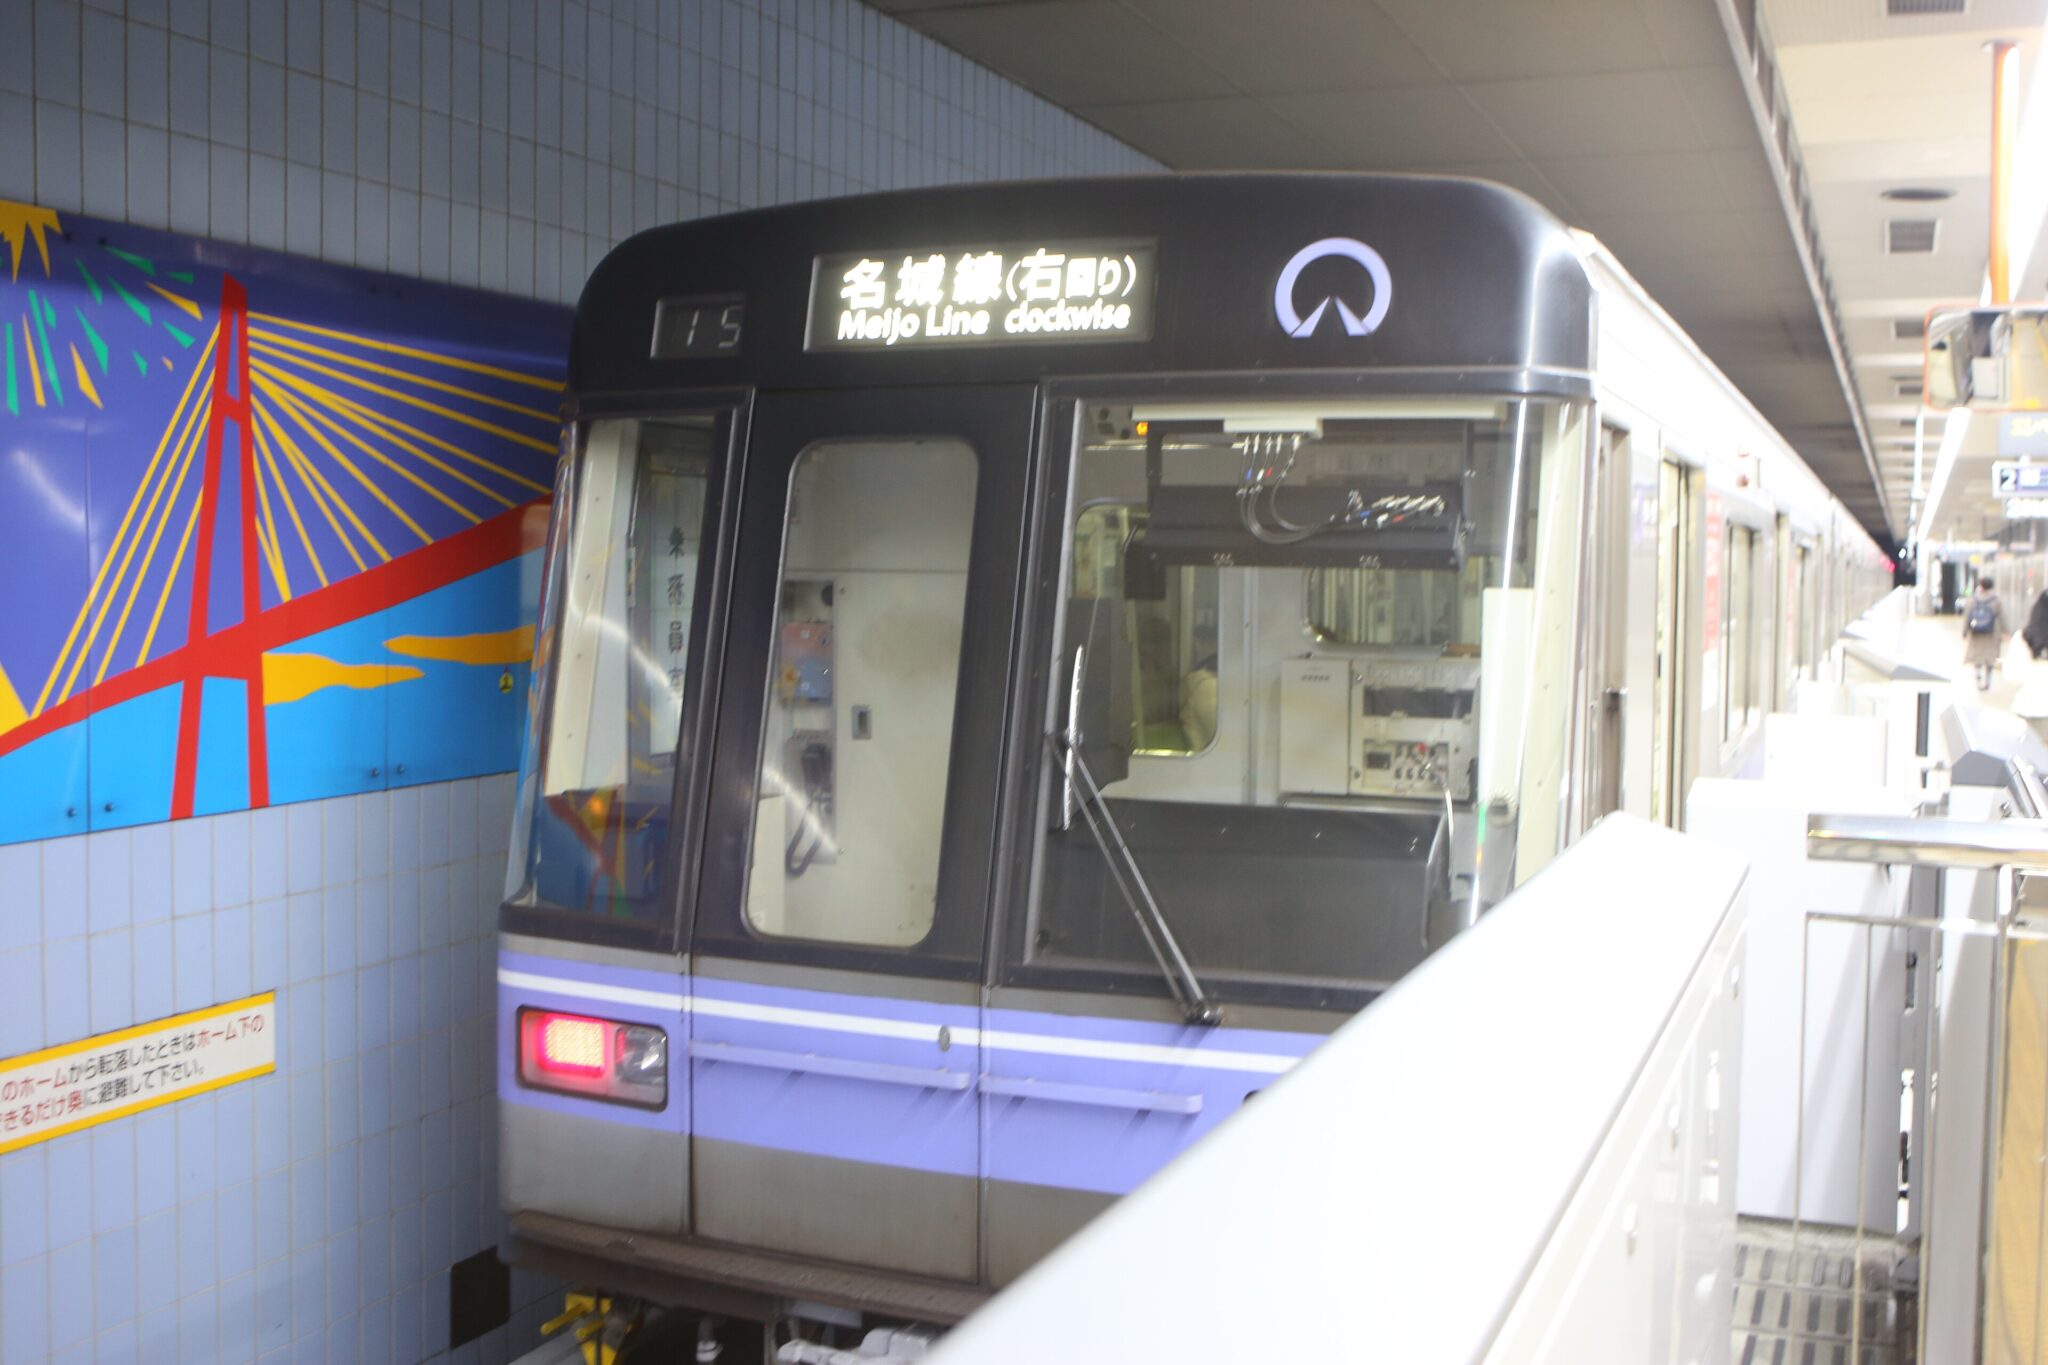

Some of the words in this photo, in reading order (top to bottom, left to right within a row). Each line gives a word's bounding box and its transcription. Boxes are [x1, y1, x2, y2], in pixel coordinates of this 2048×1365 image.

[837, 305, 920, 345] Meijo
[925, 304, 990, 337] Line
[1004, 298, 1131, 333] clockwise
